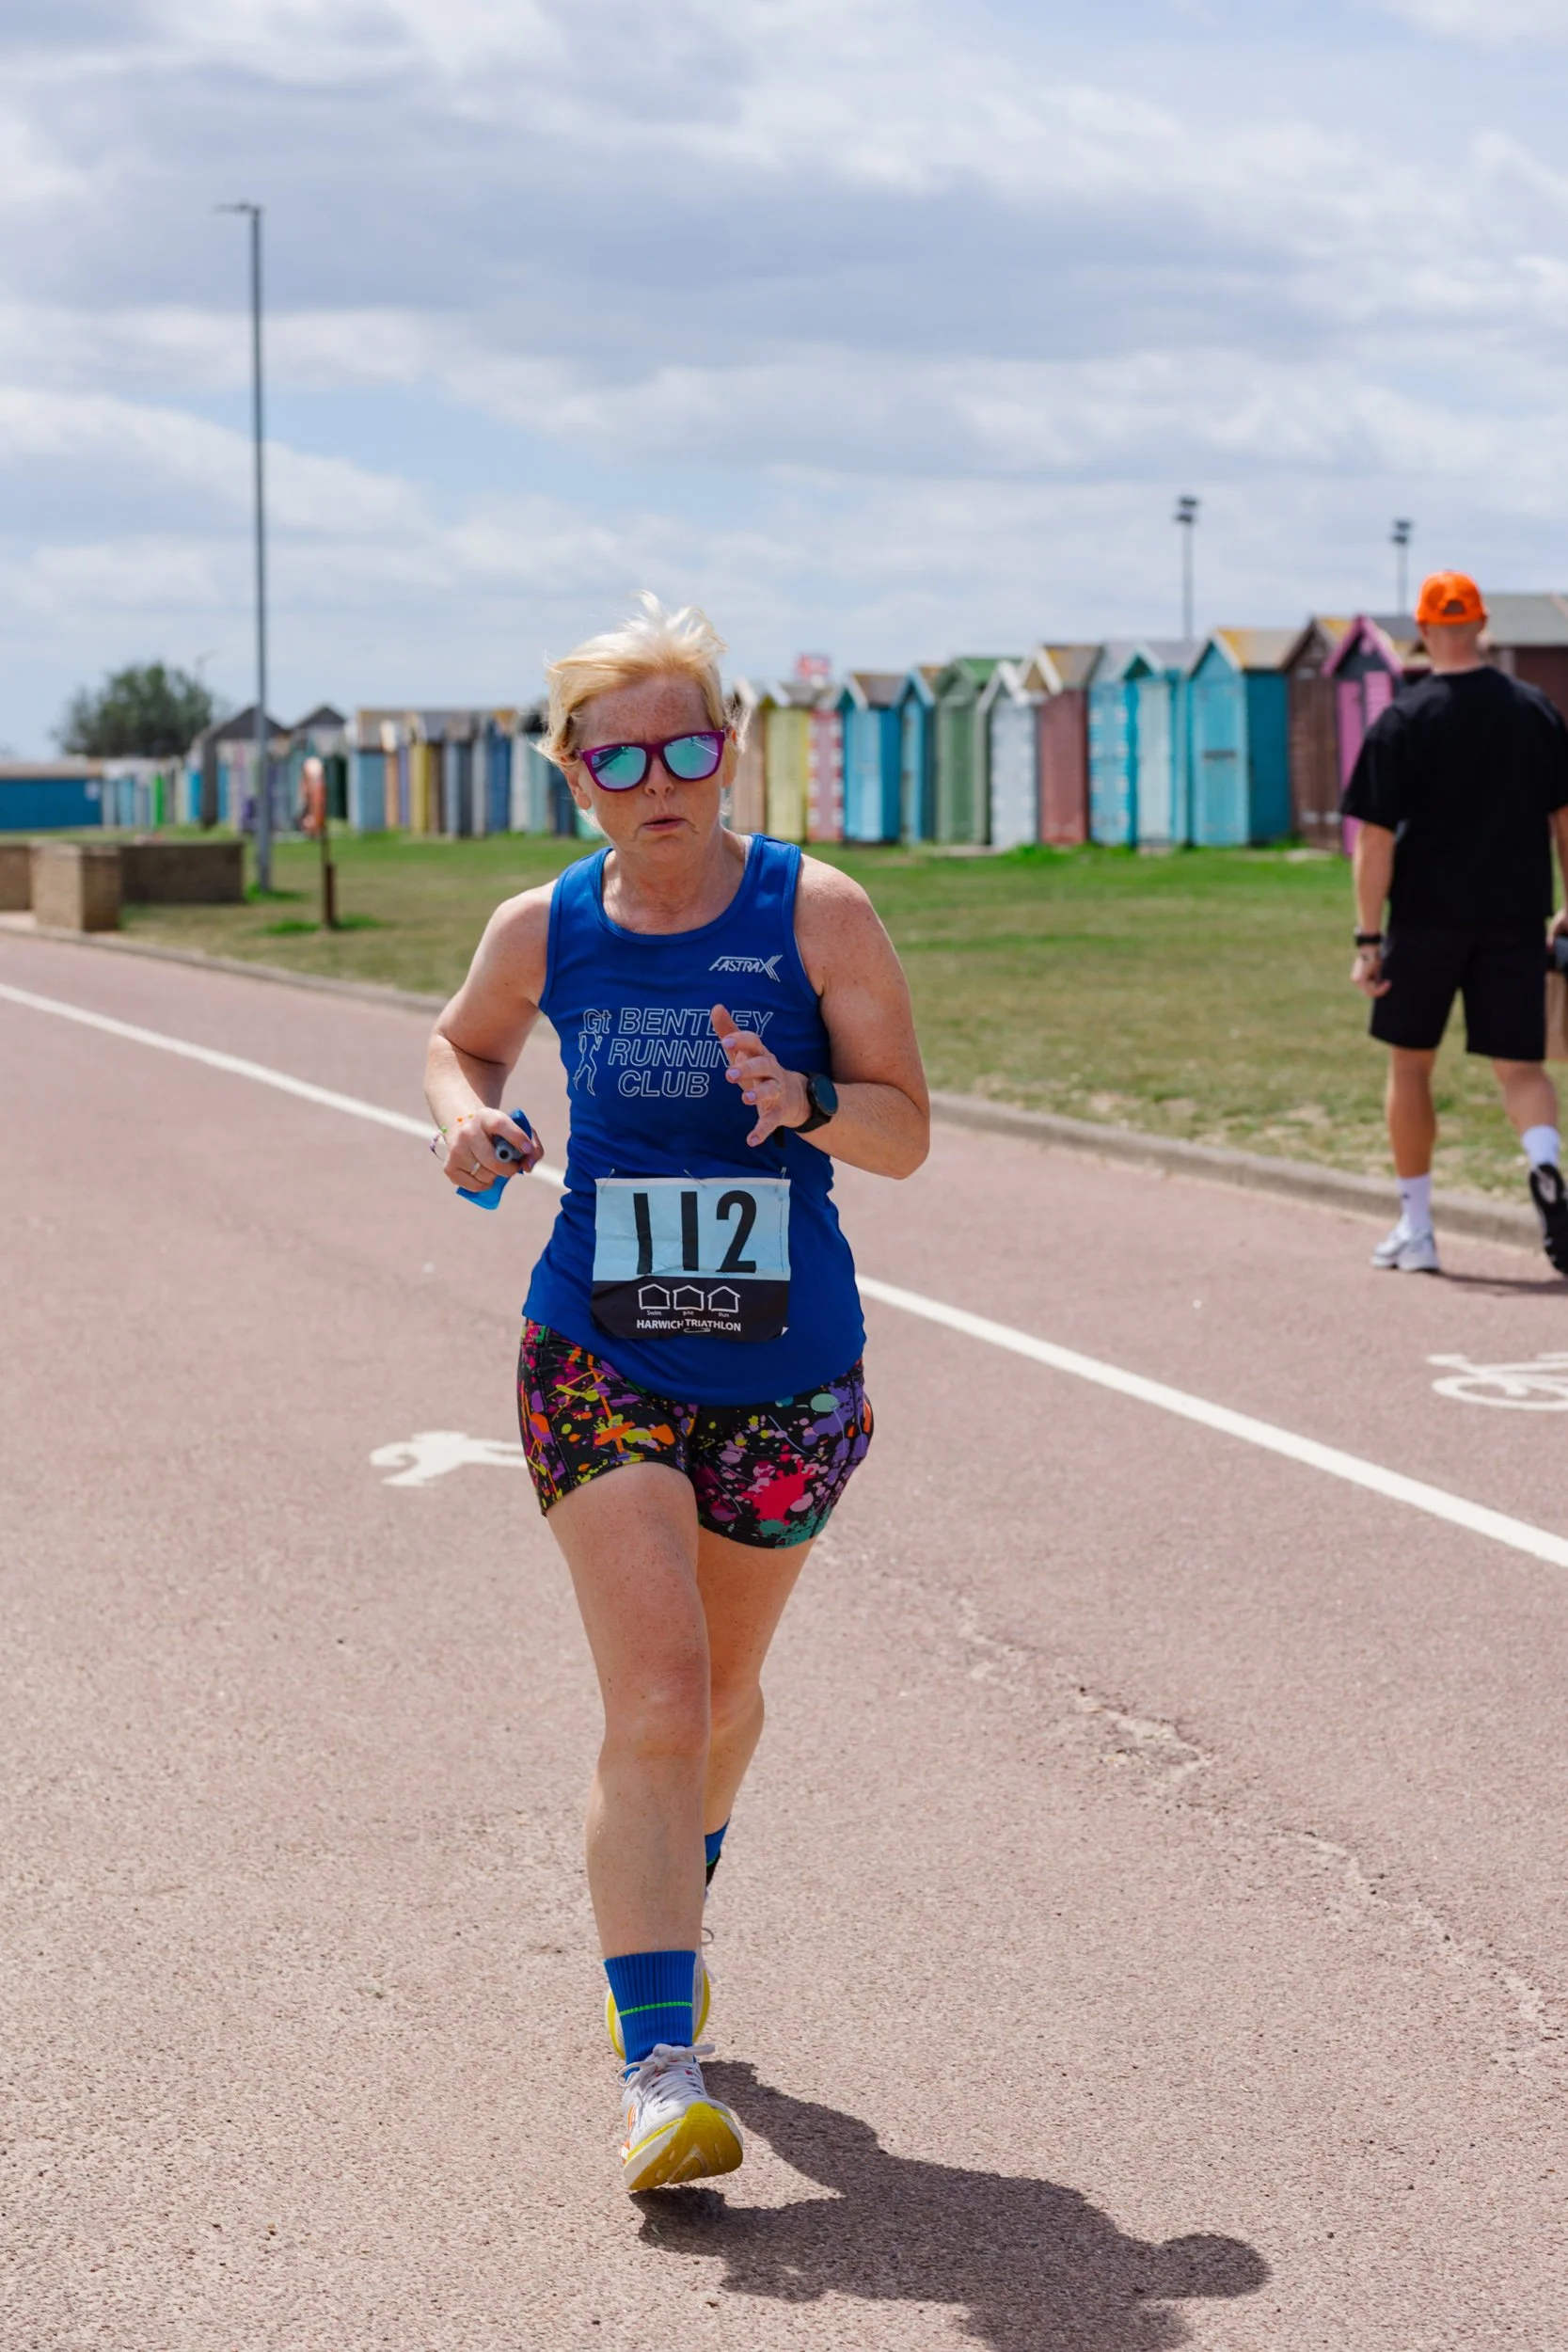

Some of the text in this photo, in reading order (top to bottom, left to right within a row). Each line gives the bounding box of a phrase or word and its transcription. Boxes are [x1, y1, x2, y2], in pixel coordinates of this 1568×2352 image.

[709, 955, 783, 982] FASTRAX
[583, 1009, 610, 1034] Gt
[608, 1039, 731, 1068] RUNNIN
[618, 1071, 709, 1098] CLUB
[633, 1190, 756, 1275] 112
[637, 1319, 741, 1331] HARWICH TRIATHLON
